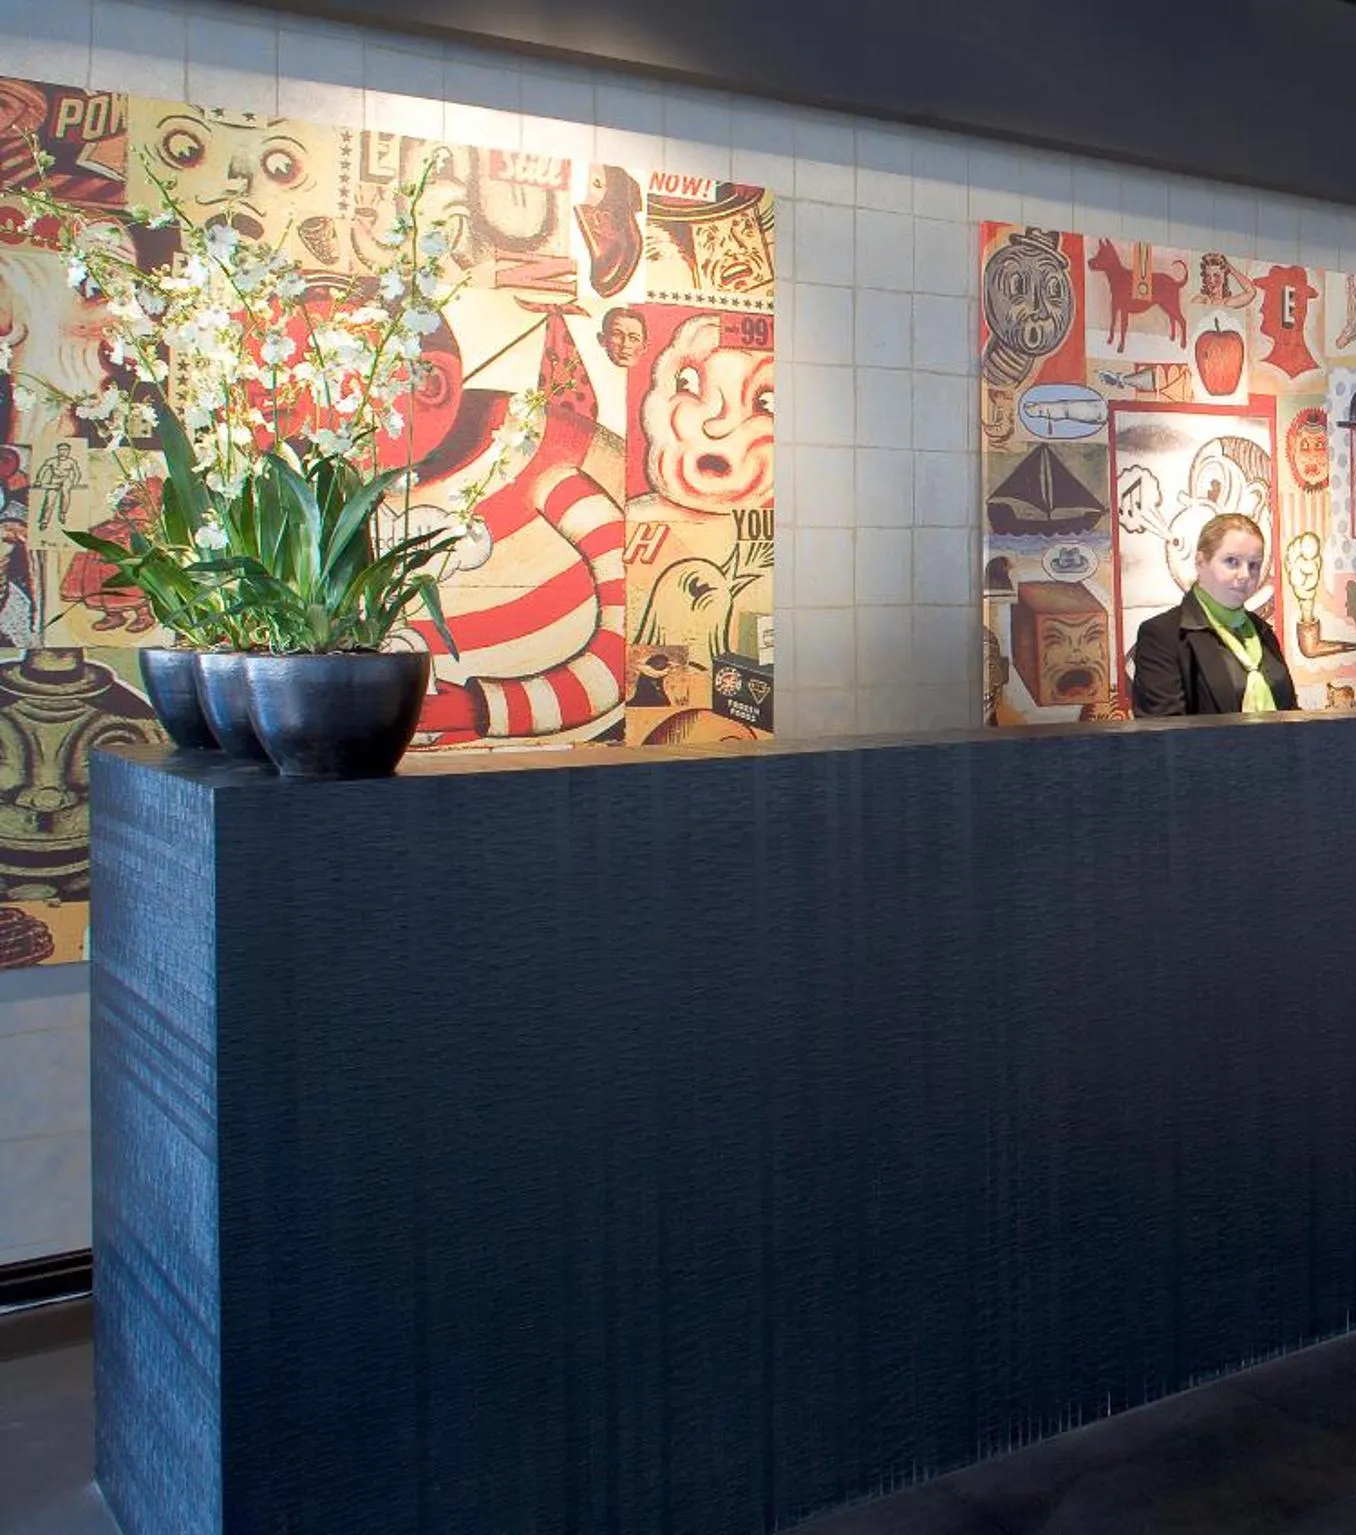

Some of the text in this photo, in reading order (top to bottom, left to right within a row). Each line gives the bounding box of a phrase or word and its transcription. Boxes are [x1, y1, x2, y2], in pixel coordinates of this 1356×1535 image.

[649, 171, 711, 198] NOW!
[741, 316, 769, 346] 99
[732, 509, 774, 540] YOU
[624, 522, 671, 564] H
